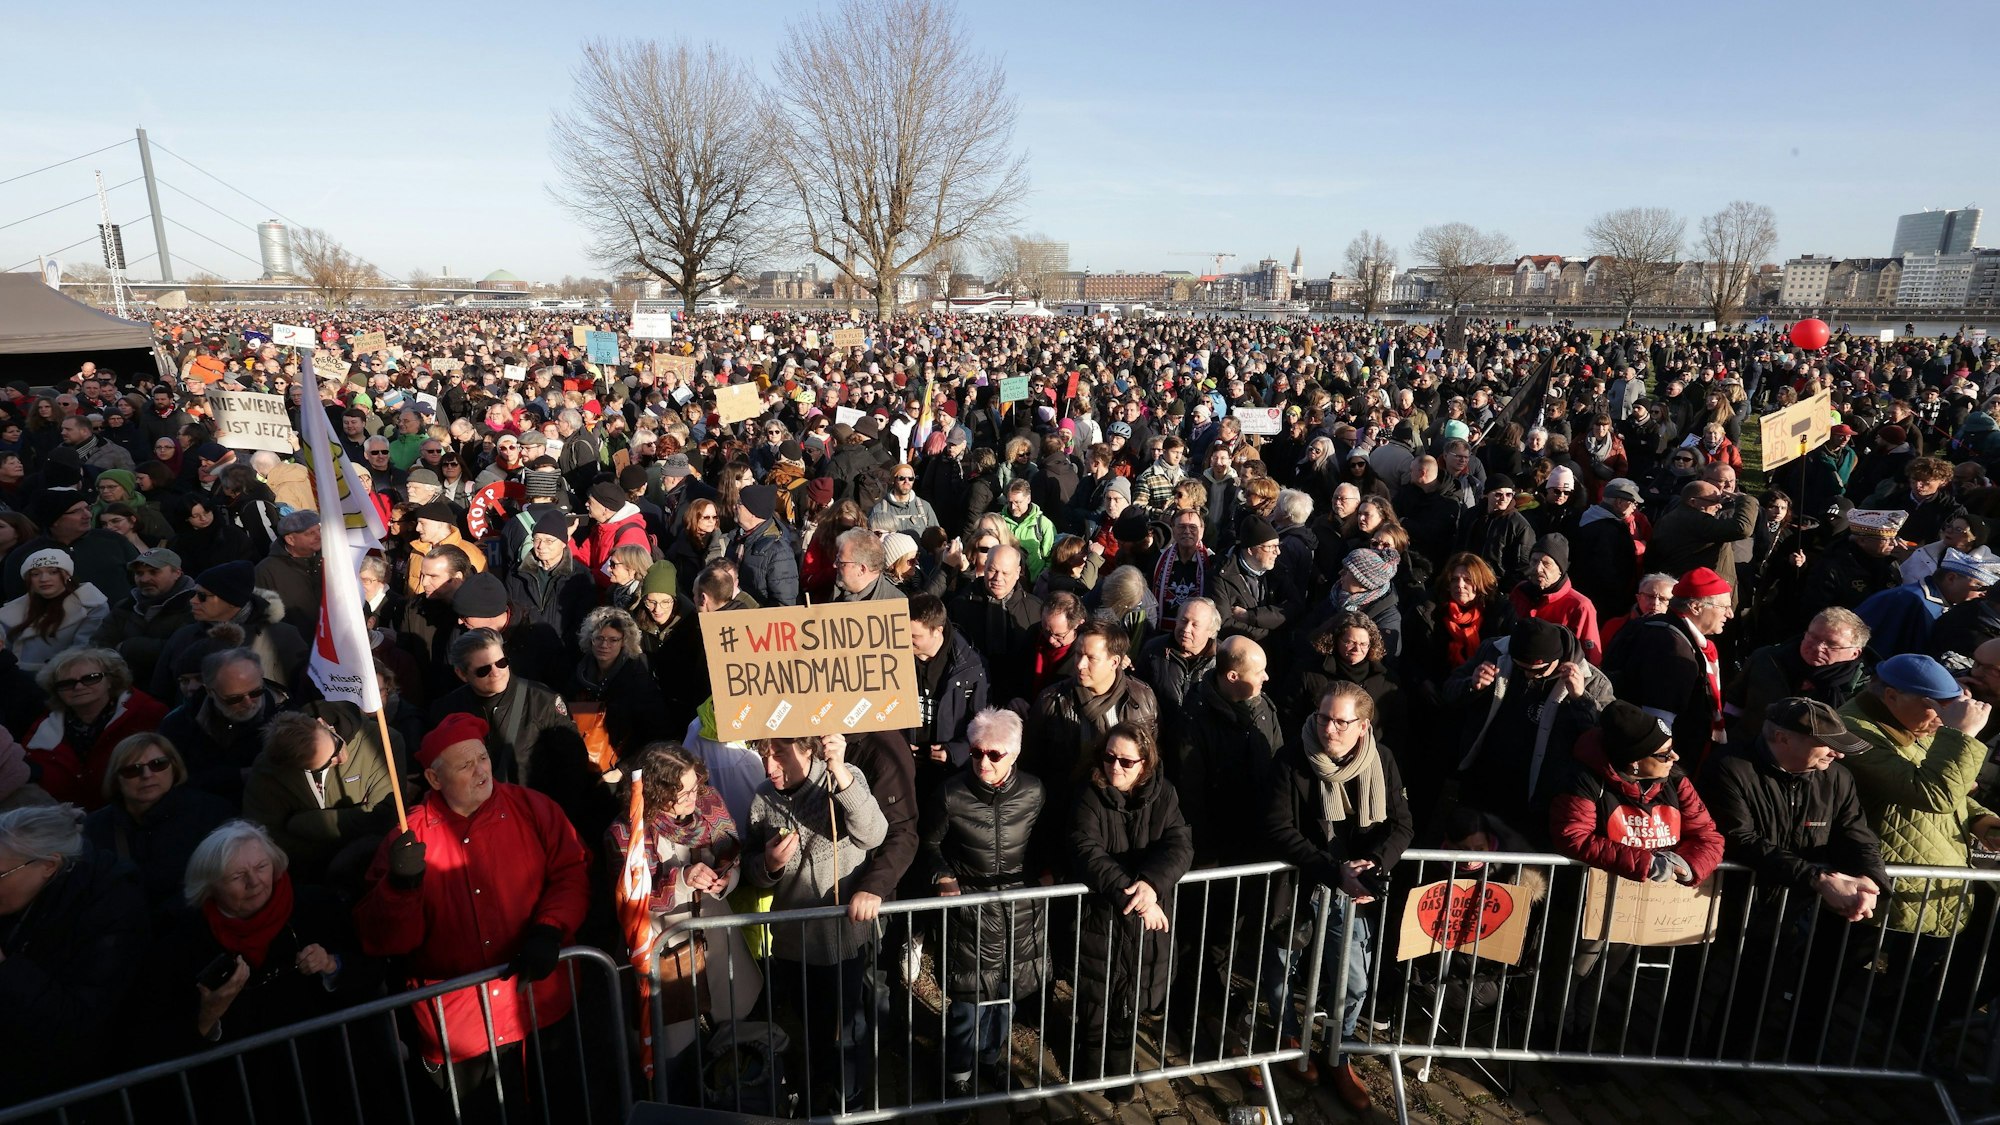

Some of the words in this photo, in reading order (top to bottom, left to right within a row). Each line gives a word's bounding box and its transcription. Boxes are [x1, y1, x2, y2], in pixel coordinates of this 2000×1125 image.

[277, 326, 291, 334] AfD
[209, 396, 236, 412] NIE
[238, 397, 287, 416] WIEDER
[226, 420, 250, 434] IST
[255, 422, 291, 439] JETZT
[1768, 417, 1788, 442] FCK
[1768, 440, 1787, 461] AFD
[471, 488, 495, 537] STOPP
[745, 622, 798, 653] WIR
[801, 617, 864, 651] SIND
[867, 612, 910, 649] DIE
[726, 653, 900, 697] BRANDMAUER
[1621, 814, 1649, 827] LEBE
[1626, 825, 1655, 838] DASS
[1656, 825, 1671, 839] DIE
[1621, 836, 1642, 848] AFD
[1645, 835, 1677, 849] ETWAS
[1591, 908, 1645, 925] NZIS
